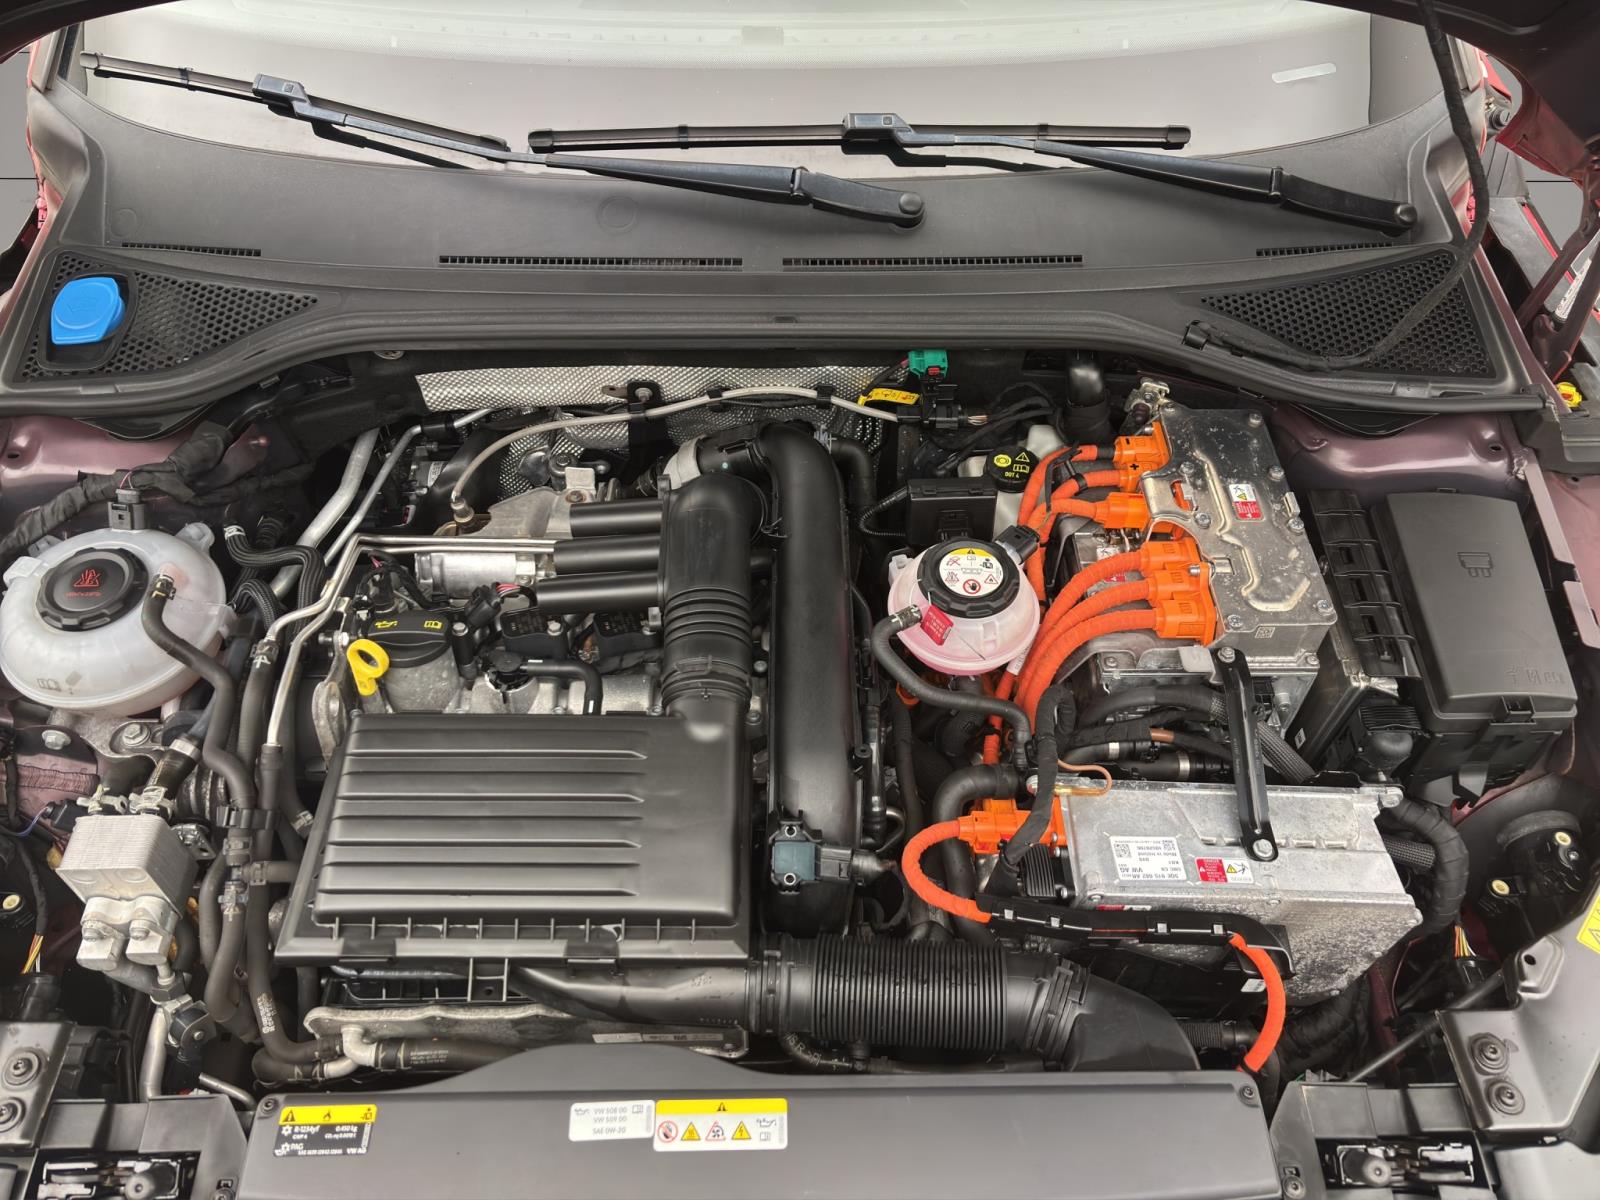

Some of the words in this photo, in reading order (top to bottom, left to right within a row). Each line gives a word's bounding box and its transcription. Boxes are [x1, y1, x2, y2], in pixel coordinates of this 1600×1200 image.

[618, 1106, 628, 1114] 00
[592, 1127, 604, 1135] SAE
[605, 1126, 627, 1134] 0W-20
[290, 1142, 304, 1150] PAG
